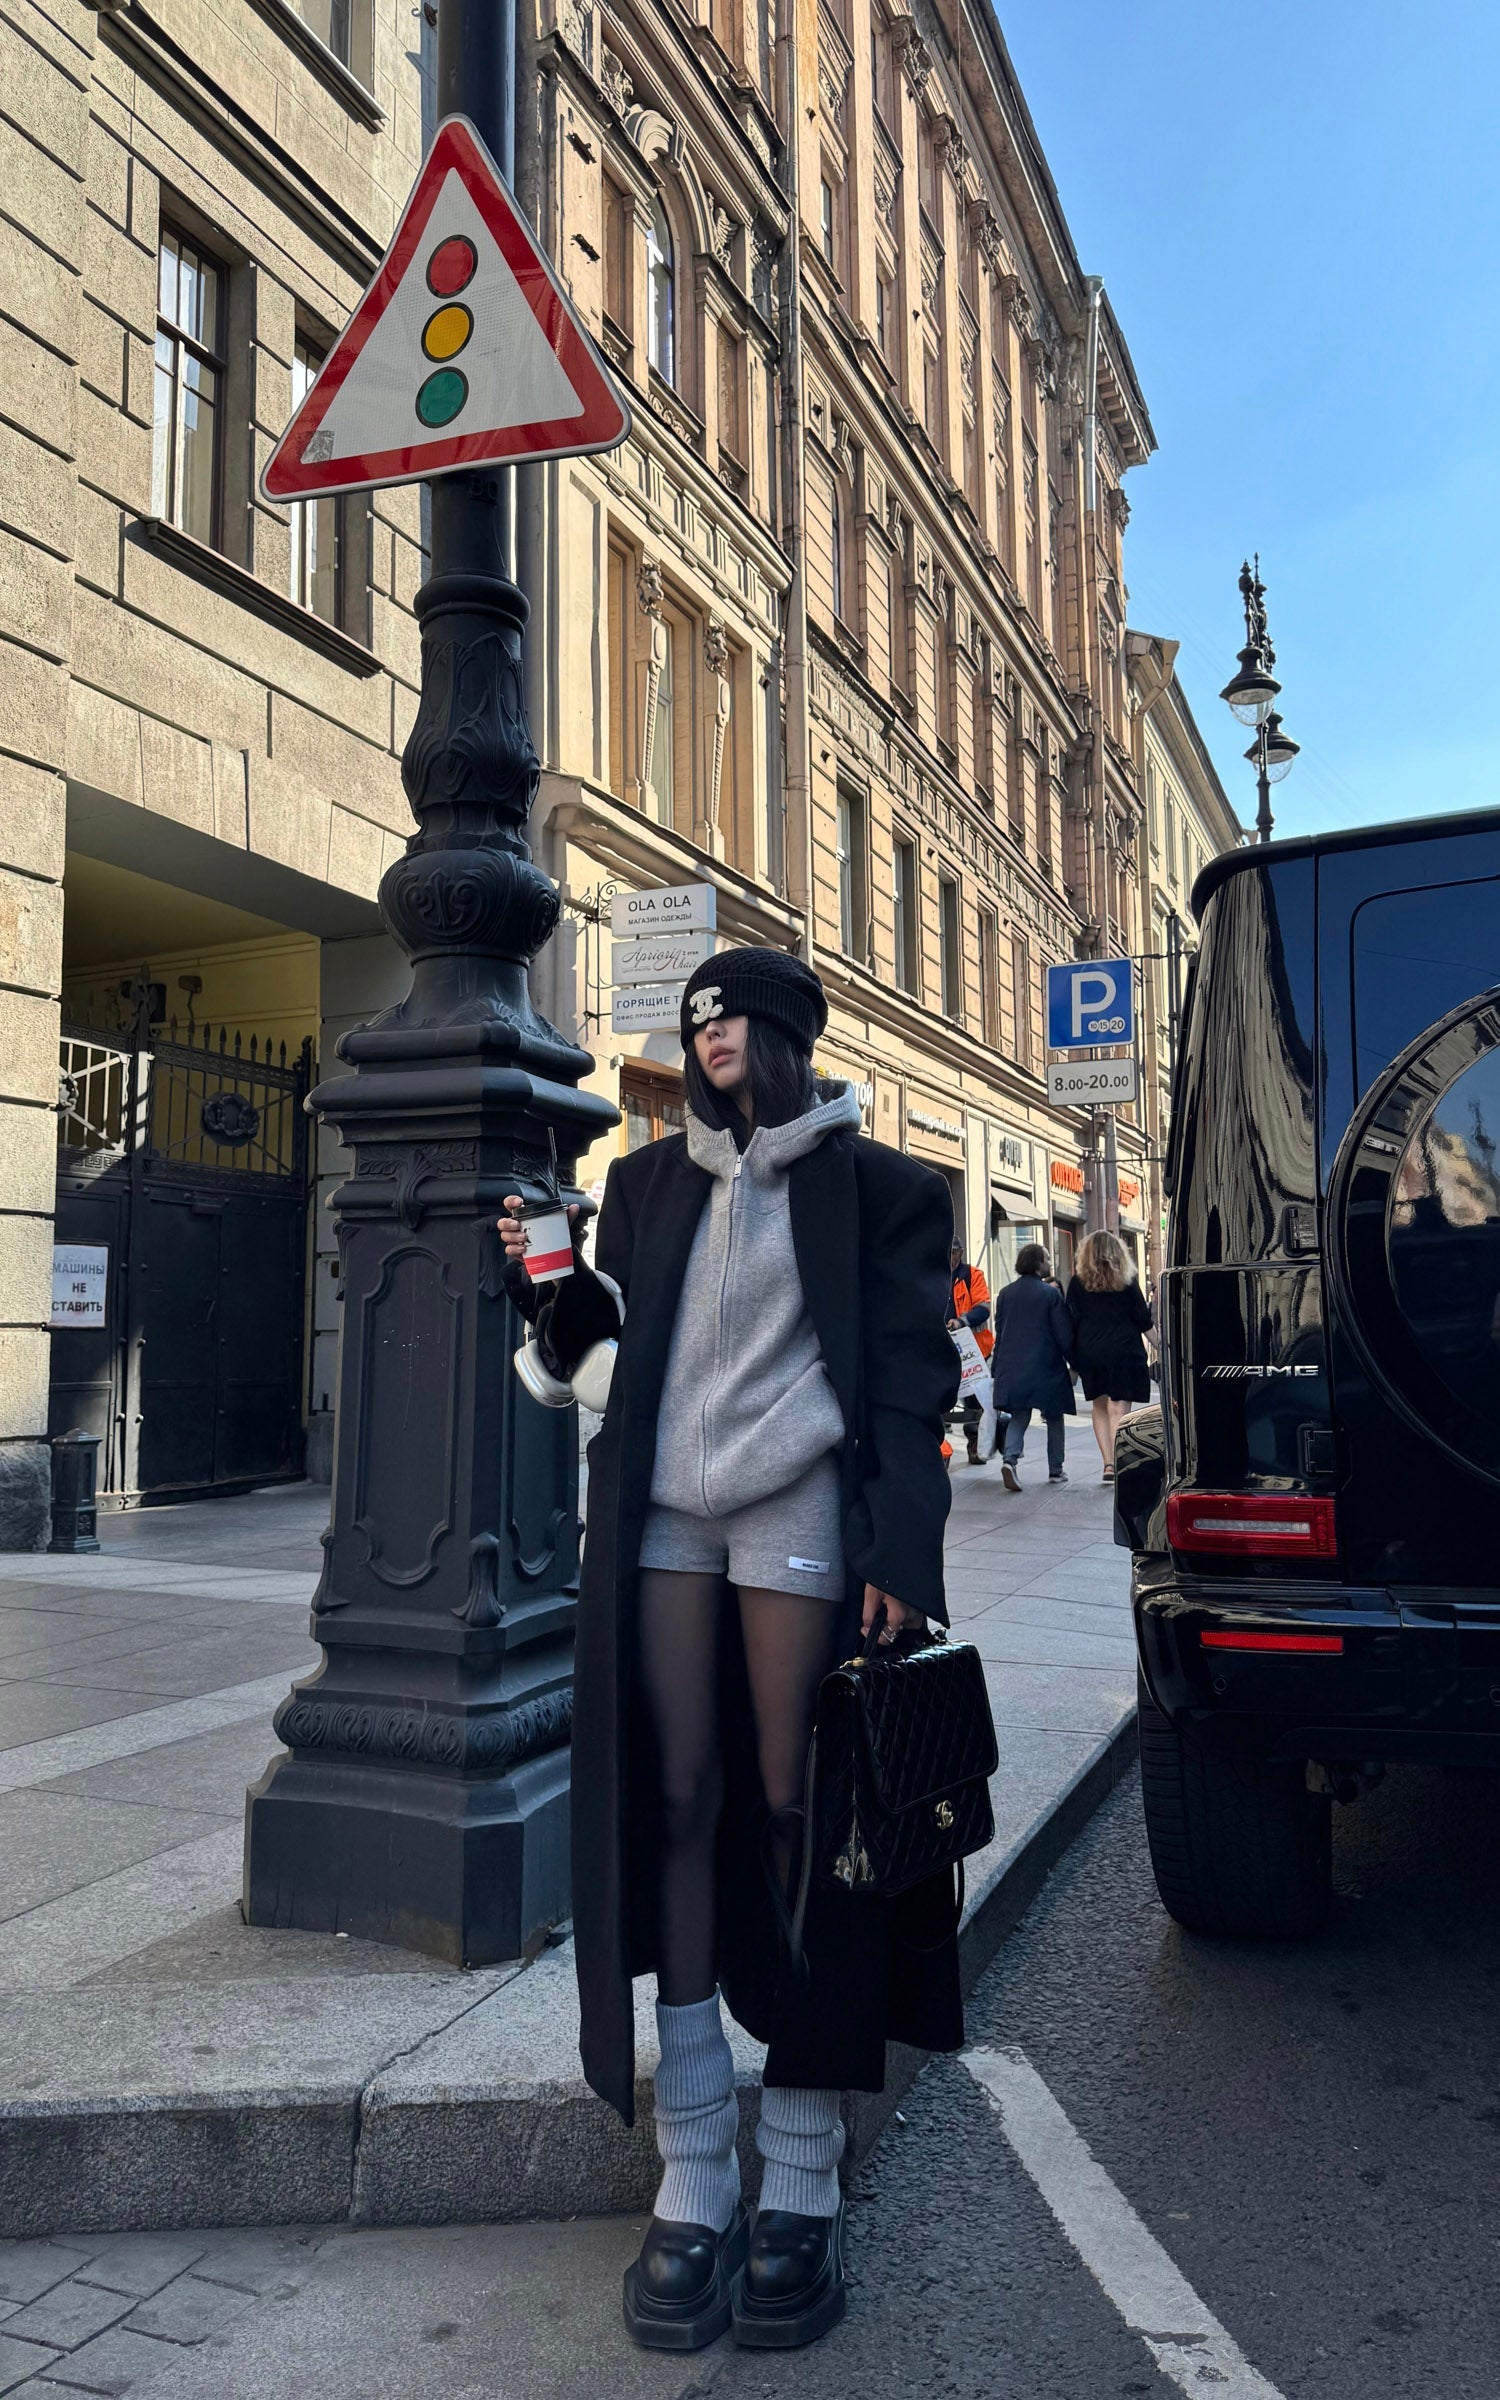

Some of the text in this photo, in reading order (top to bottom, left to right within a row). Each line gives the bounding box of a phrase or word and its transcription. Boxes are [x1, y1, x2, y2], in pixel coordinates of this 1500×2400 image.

[628, 895, 691, 912] OLA OLA
[628, 913, 692, 926] МАГАЗИН ОДЕЖДЫ
[616, 995, 684, 1010] ГОРЯЩИЕ Т
[1071, 971, 1117, 1038] P
[616, 1012, 634, 1021] ОФИС
[635, 1010, 661, 1020] ПРОДАЖ
[1100, 1021, 1108, 1030] 15
[1111, 1020, 1124, 1030] 20
[1054, 1074, 1129, 1091] 8.00-20.00
[53, 1262, 105, 1275] МАШИНЫ
[72, 1282, 87, 1293] НЕ
[52, 1301, 103, 1312] СТАВИТЬ
[1243, 1365, 1319, 1377] AMG
